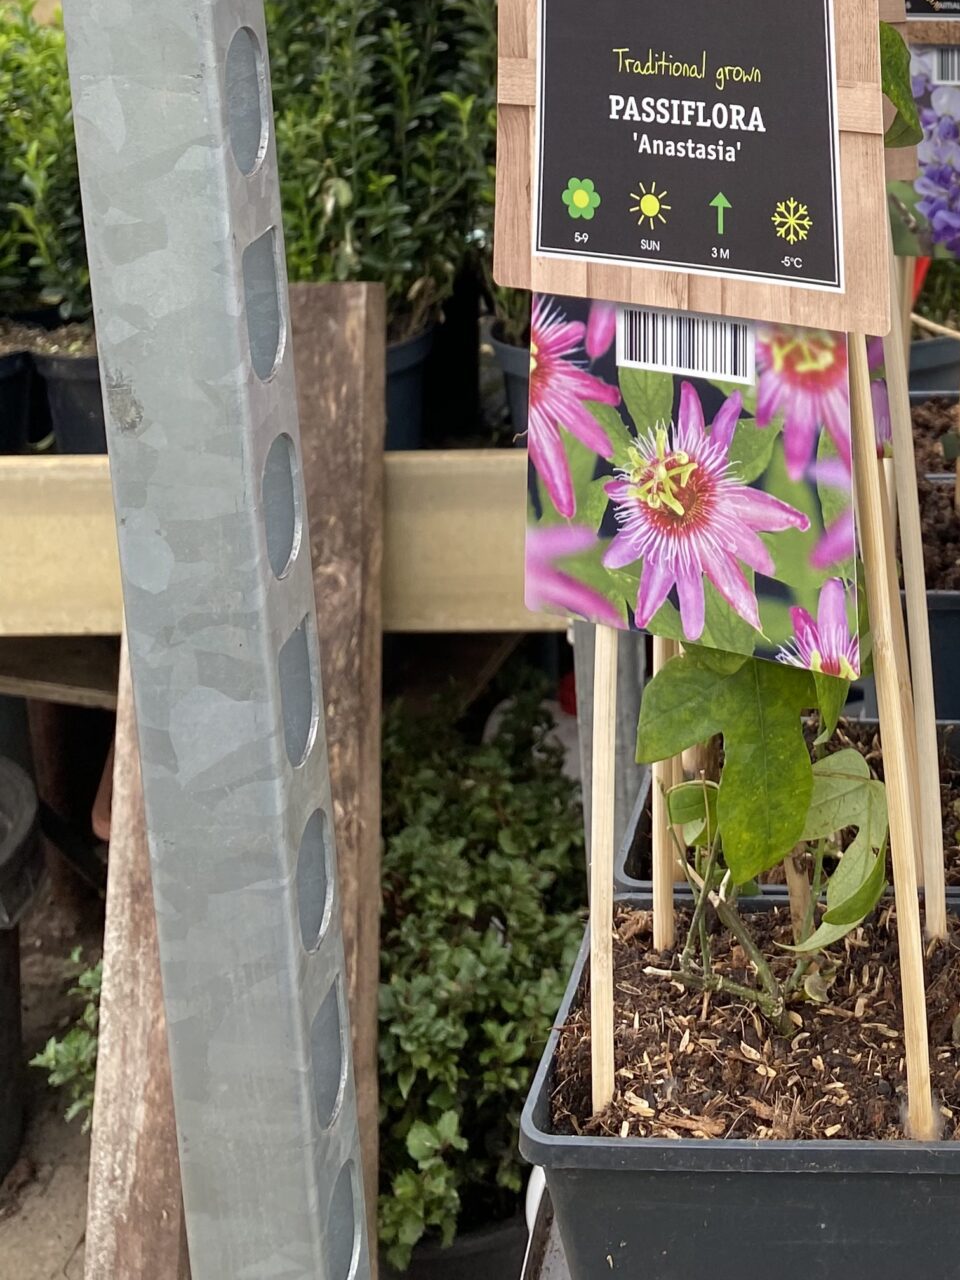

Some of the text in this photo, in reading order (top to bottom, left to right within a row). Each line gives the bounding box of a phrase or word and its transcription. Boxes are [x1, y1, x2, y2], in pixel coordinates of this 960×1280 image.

[612, 48, 762, 91] Traditional grown
[608, 94, 767, 133] PASSIFLORA
[633, 132, 742, 163] 'Anastasia'
[574, 231, 589, 244] 5-9
[640, 238, 661, 252] SUN
[711, 247, 730, 260] 3 M
[780, 256, 803, 269] -5°C
